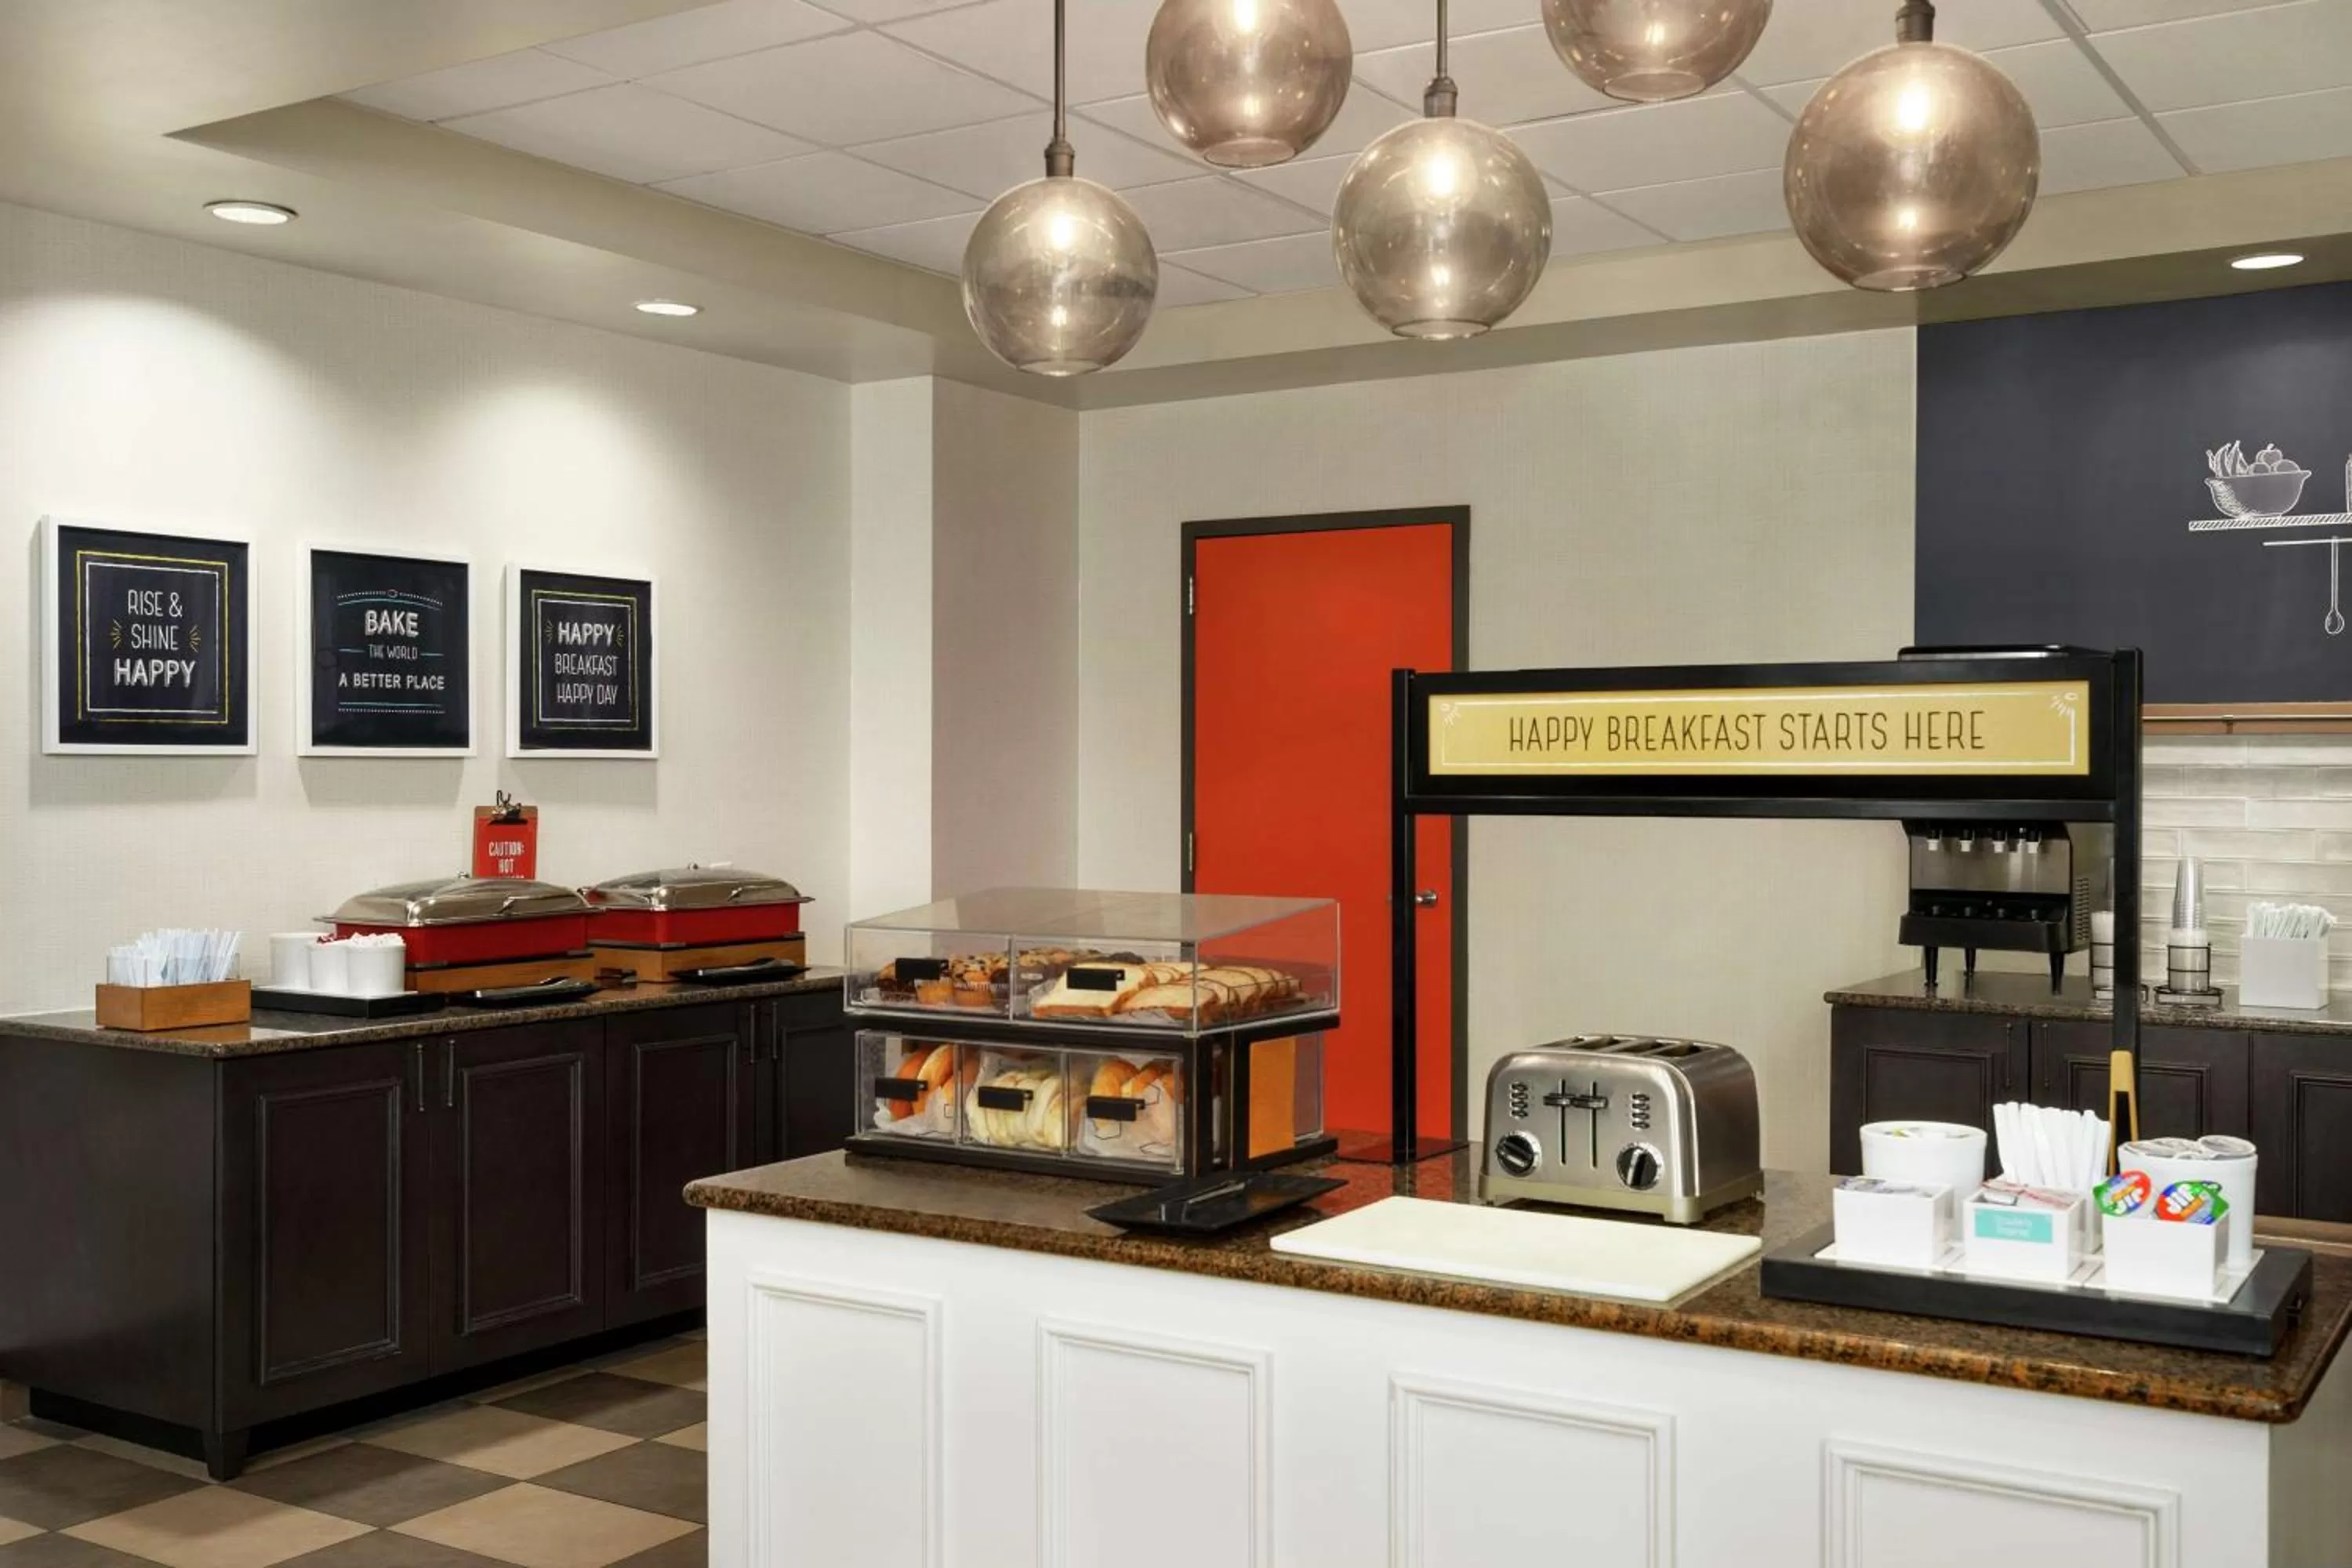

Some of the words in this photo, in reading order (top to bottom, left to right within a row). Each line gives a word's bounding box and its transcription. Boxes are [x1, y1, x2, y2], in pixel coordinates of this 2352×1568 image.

[128, 589, 163, 617] RISE
[169, 592, 183, 618] &
[364, 609, 419, 637] BAKE
[557, 621, 615, 647] HAPPY
[131, 622, 179, 651] SHINE
[368, 644, 383, 659] THE
[387, 644, 418, 660] WORLD
[554, 653, 619, 677] BREAKFAST
[114, 658, 196, 688] HAPPY
[338, 673, 348, 688] A
[354, 673, 401, 688] BETTER
[407, 675, 445, 690] PLACE
[557, 683, 593, 705] HAPPY
[597, 684, 618, 705] DAY
[1509, 716, 1594, 752] HAPPY
[1607, 713, 1767, 751] BREAKFAST
[1779, 712, 1888, 750] STARTS
[1905, 710, 1985, 750] HERE
[498, 858, 514, 873] HOT
